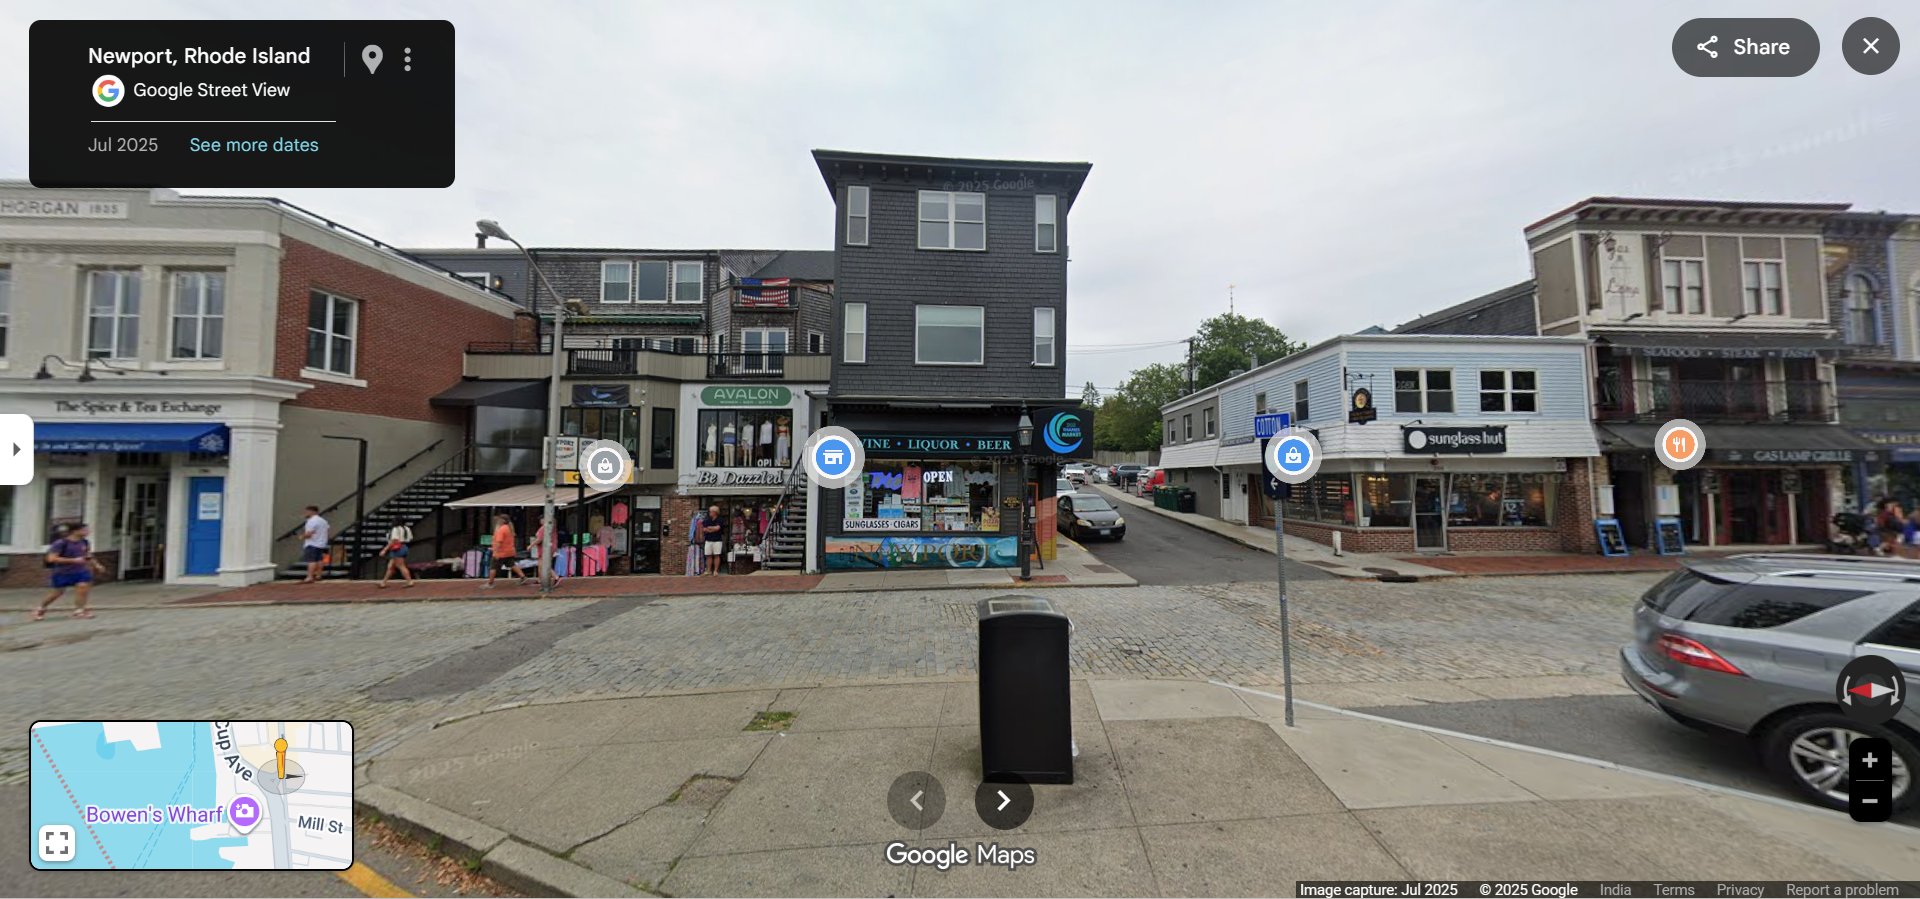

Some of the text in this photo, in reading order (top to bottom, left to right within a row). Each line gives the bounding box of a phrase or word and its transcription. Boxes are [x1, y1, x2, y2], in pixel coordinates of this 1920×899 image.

[713, 388, 780, 400] AVALON
[55, 401, 222, 415] The Spice & Tea Exchange
[1256, 416, 1281, 436] COTTON
[854, 439, 1012, 451] WINE LIQUOR BEER
[1427, 431, 1504, 448] sunglass hut
[697, 469, 784, 485] Be Dazzled
[922, 470, 954, 483] OPEN
[845, 520, 919, 529] SUNGLASSES CIGARS
[853, 543, 998, 563] NEWPORT
